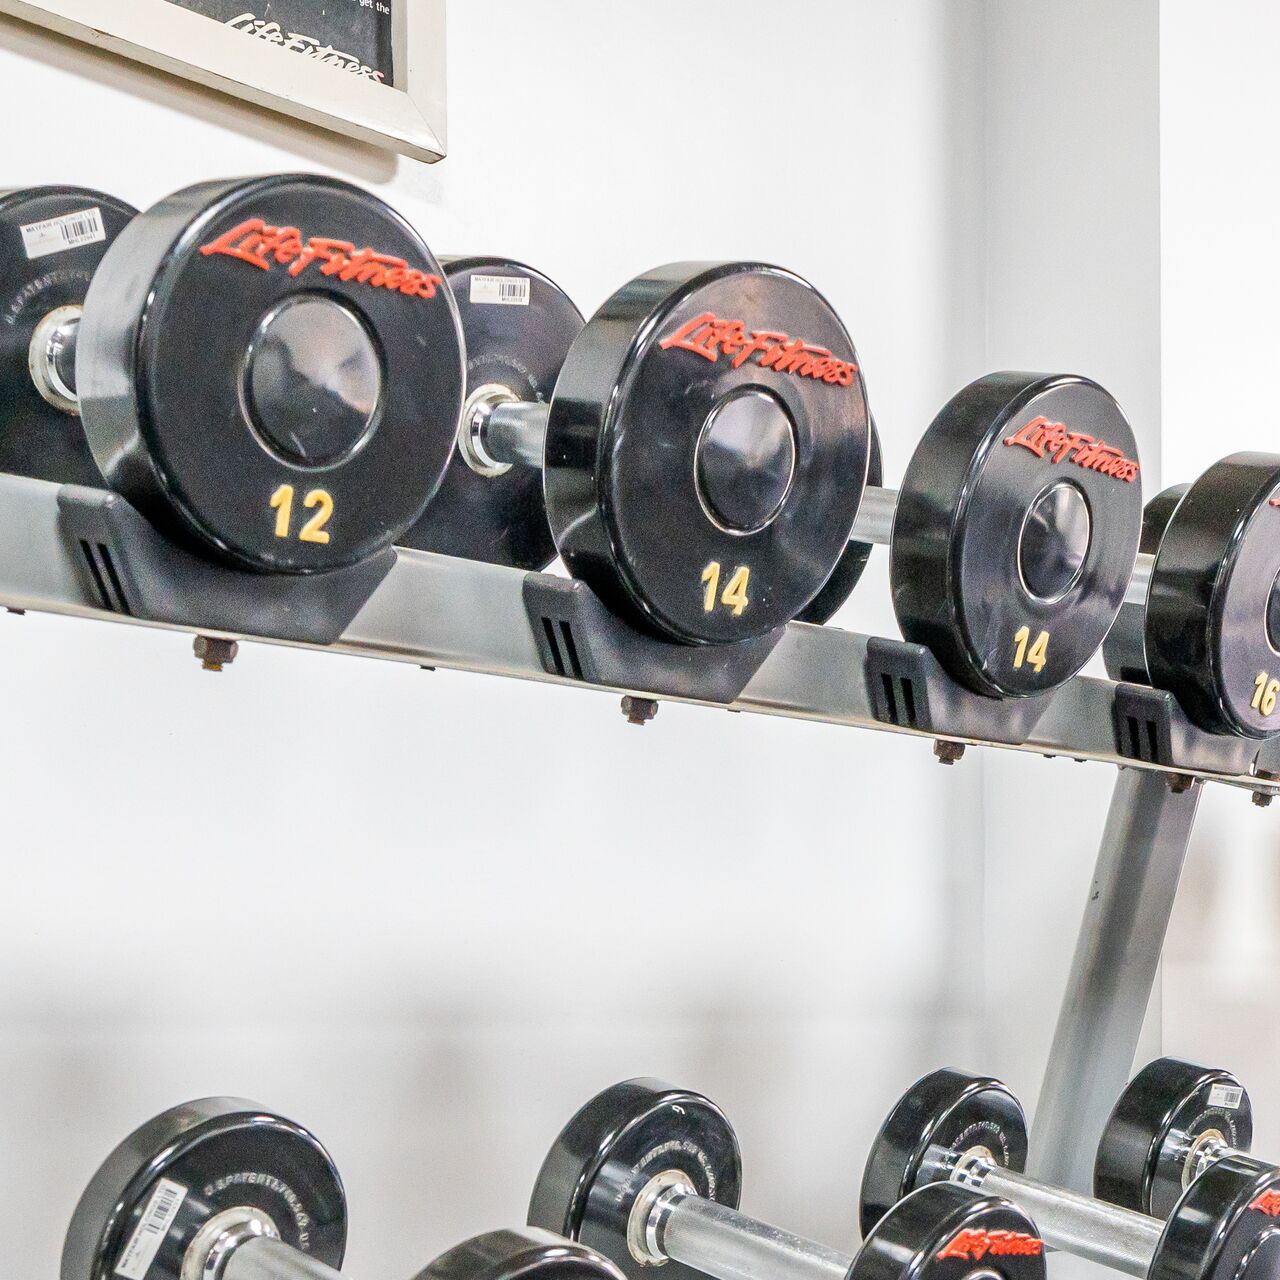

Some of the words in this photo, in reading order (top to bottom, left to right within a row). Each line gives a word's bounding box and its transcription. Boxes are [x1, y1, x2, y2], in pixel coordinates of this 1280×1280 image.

[376, 2, 390, 15] the
[199, 218, 302, 272] Life
[288, 235, 442, 299] Fitness
[659, 311, 747, 362] Life
[732, 329, 859, 387] Fitness
[1003, 414, 1068, 458] Life
[1054, 431, 1141, 483] Fitness
[269, 483, 334, 544] 12
[700, 560, 751, 617] 14
[1012, 625, 1051, 673] 14
[1249, 670, 1280, 717] 16
